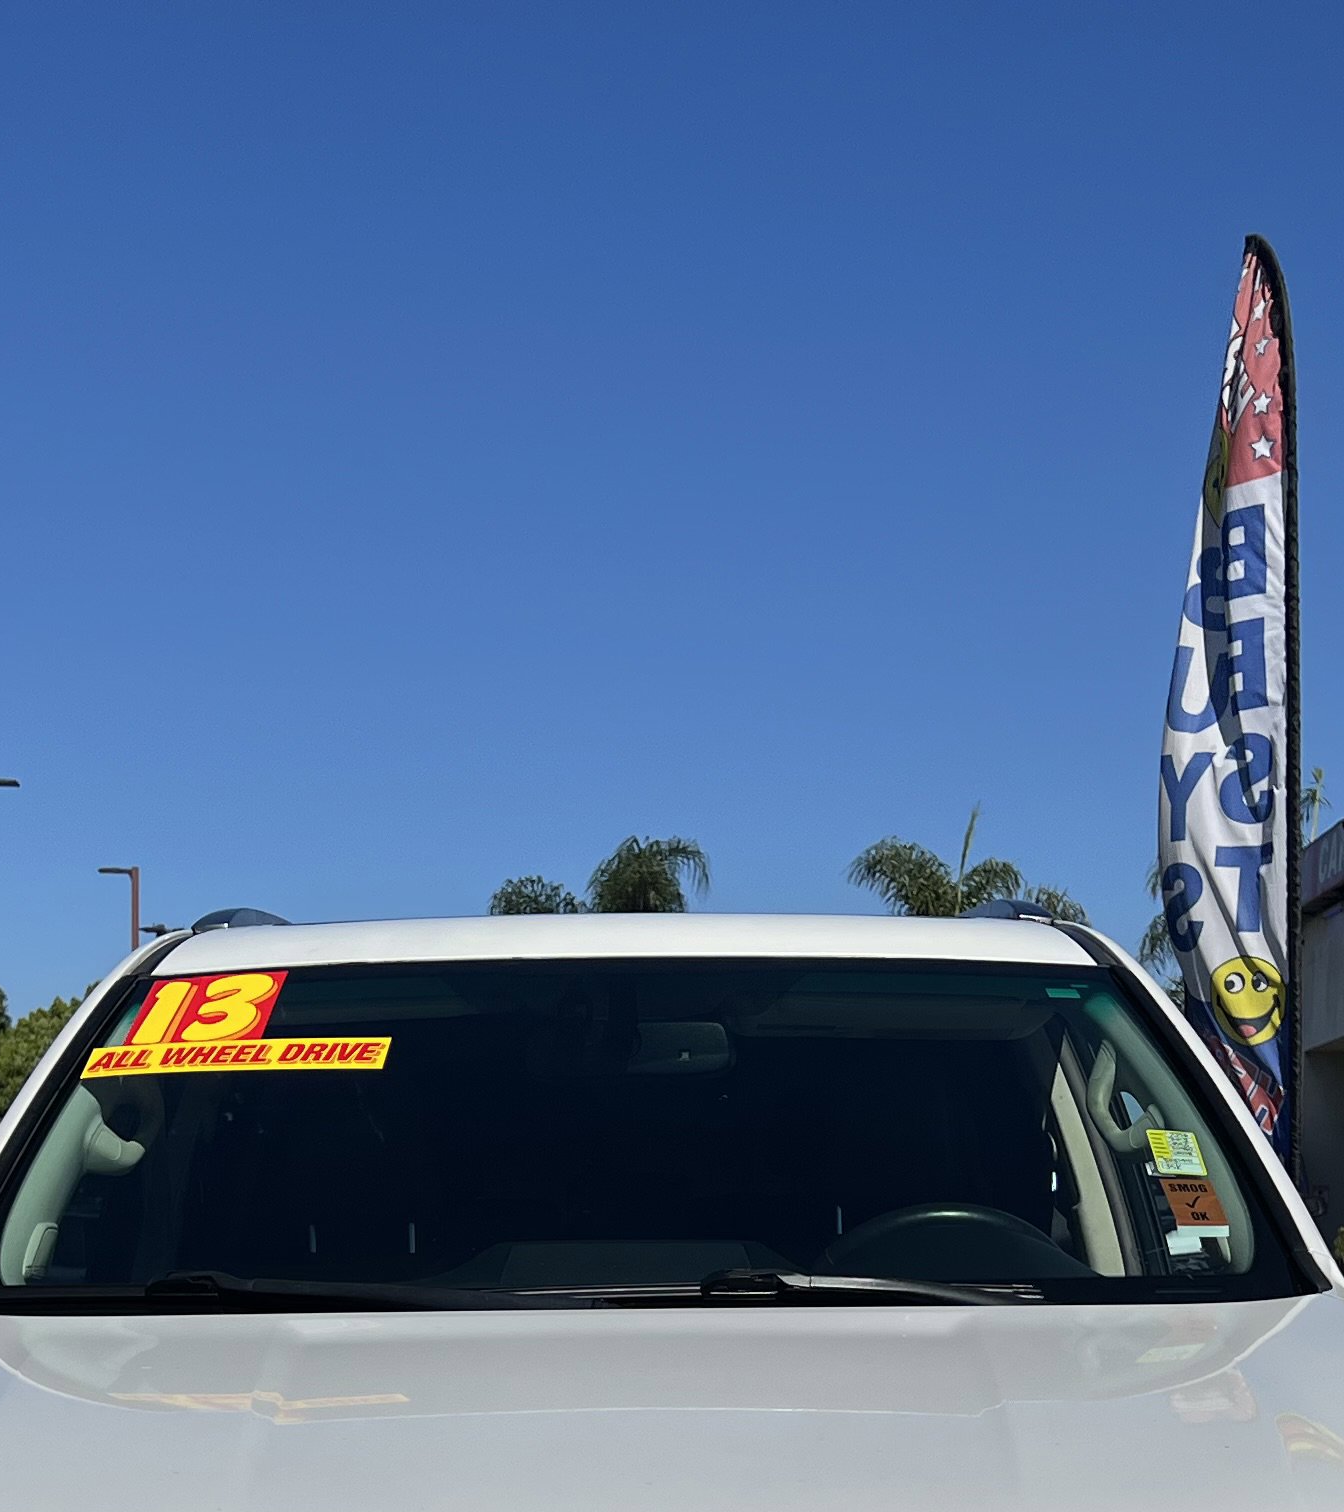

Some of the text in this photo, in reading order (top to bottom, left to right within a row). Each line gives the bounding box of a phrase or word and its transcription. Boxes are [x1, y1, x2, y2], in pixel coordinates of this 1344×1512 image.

[131, 972, 279, 1044] 13
[88, 1042, 384, 1073] ALL WHEEL DRIVE
[1168, 1183, 1209, 1193] SMOG
[1191, 1211, 1211, 1221] OK
